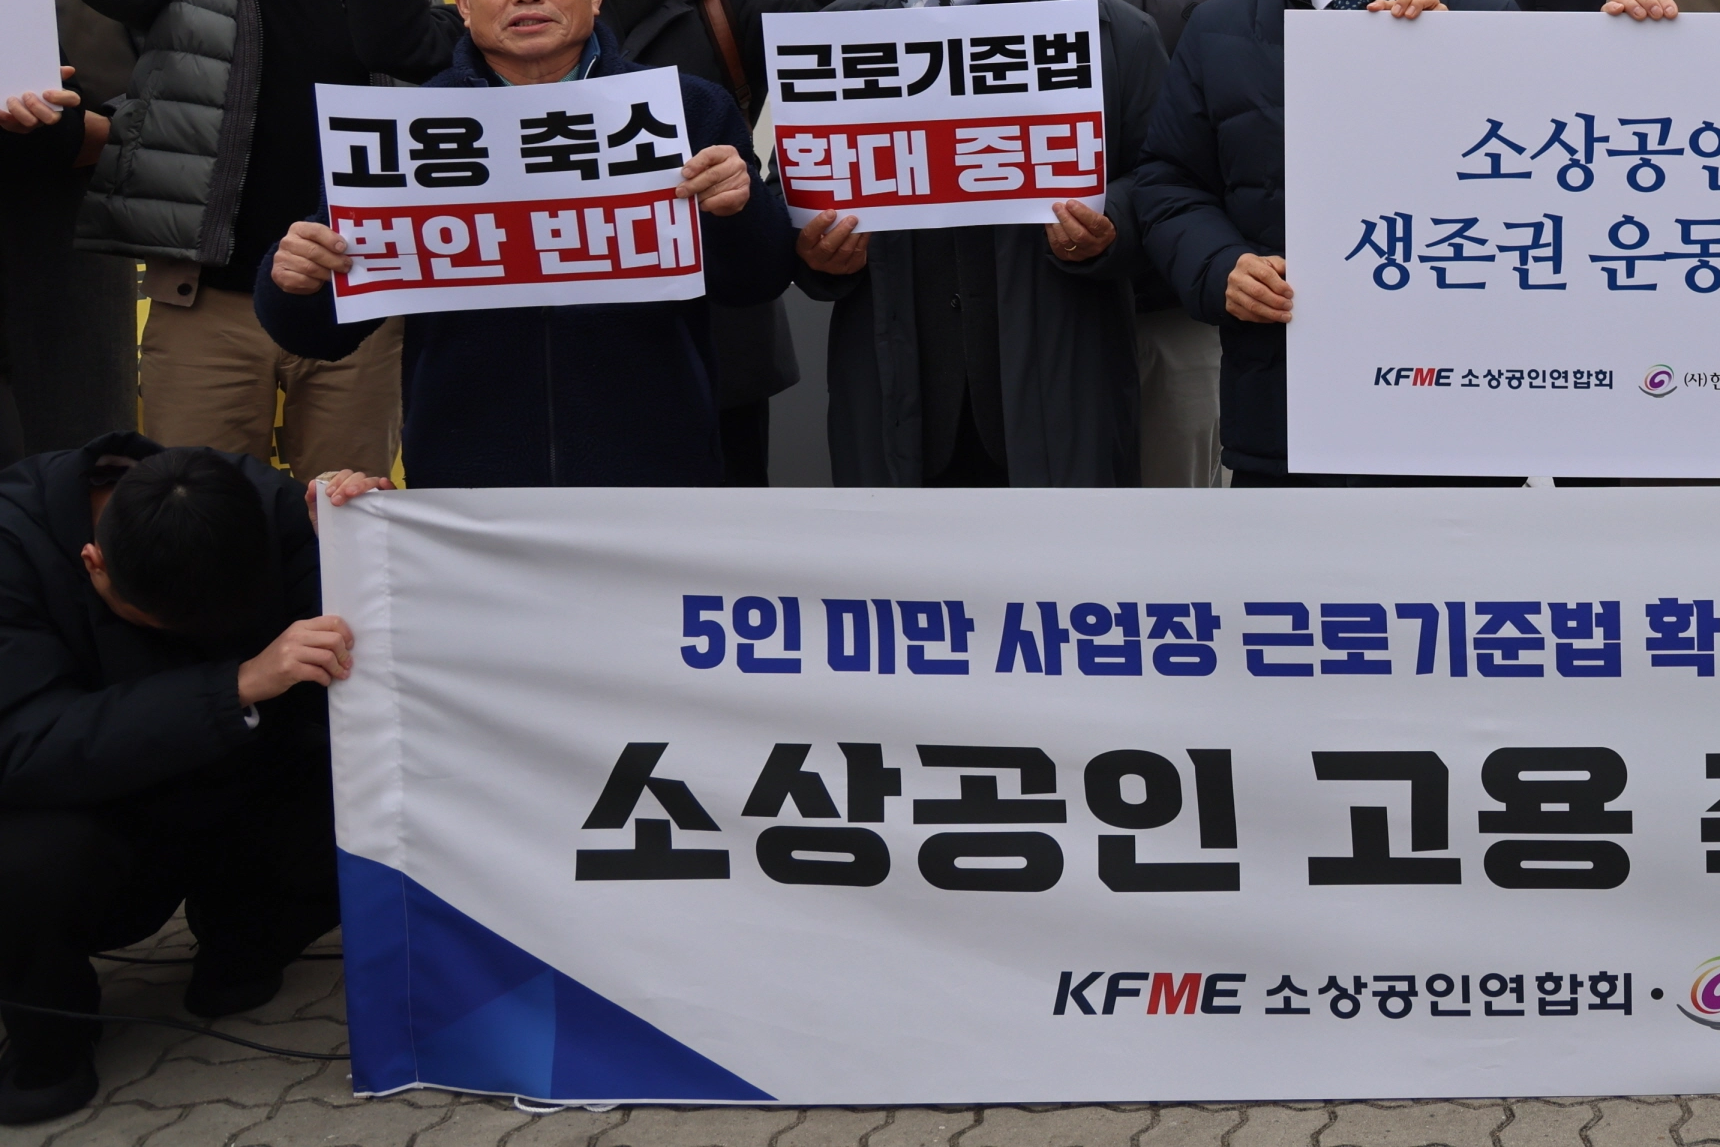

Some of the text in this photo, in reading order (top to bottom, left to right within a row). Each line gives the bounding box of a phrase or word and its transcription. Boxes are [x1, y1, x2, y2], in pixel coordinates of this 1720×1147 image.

[776, 30, 1093, 103] 근로기준법
[328, 101, 684, 188] 고용 축소
[781, 121, 1102, 202] 확대 중단
[337, 198, 697, 287] 법안 반대
[1344, 211, 1568, 291] 생존권
[1373, 367, 1454, 387] KFME
[1460, 368, 1614, 390] 소상공인연합회
[679, 594, 802, 674] 5인
[820, 597, 975, 675] 미만
[995, 600, 1222, 678] 사업장
[1242, 600, 1622, 678] 근로기준법
[575, 741, 1240, 893] 소상공인
[1307, 746, 1634, 890] 고용
[1052, 970, 1247, 1016] KFME
[1264, 970, 1633, 1020] 소상공인연합회
